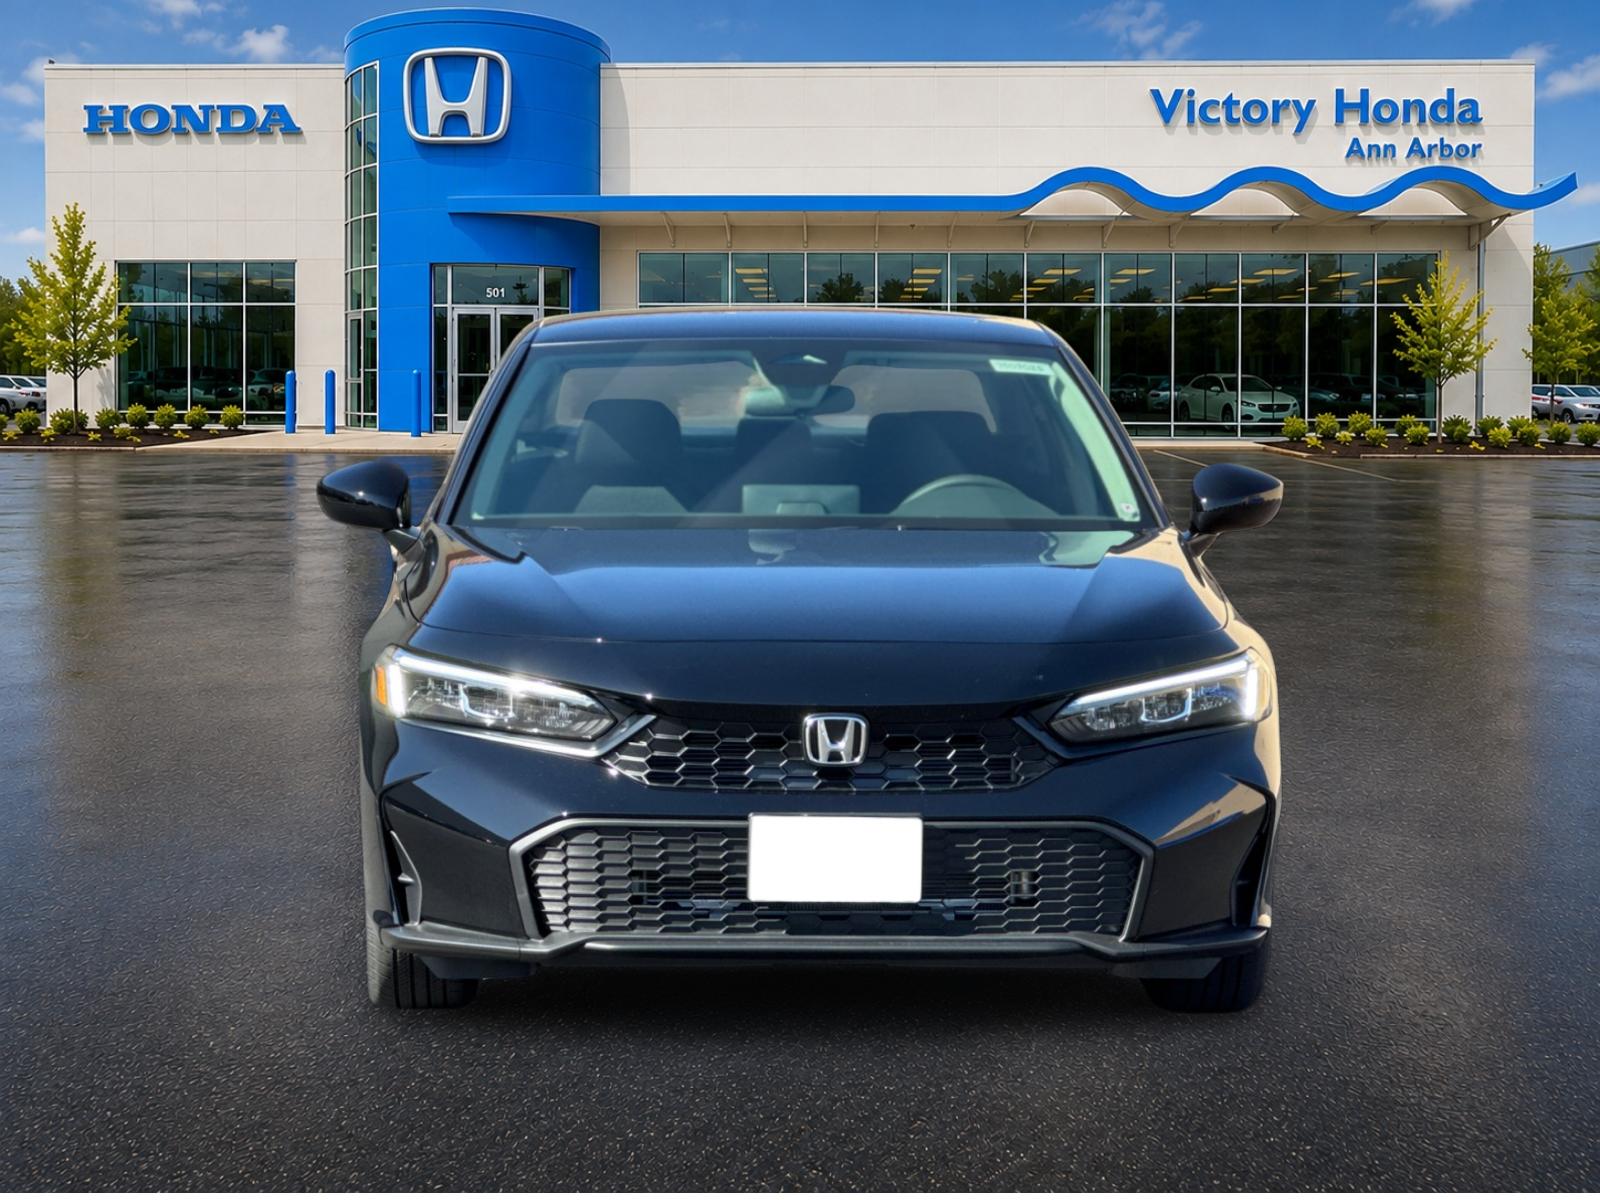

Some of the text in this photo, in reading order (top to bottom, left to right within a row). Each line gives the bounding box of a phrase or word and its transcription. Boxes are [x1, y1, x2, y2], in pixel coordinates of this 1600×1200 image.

[83, 103, 303, 136] HONDA
[1149, 87, 1483, 136] Victory Honda
[1345, 136, 1483, 159] Ann Arbor
[485, 287, 505, 298] 501
